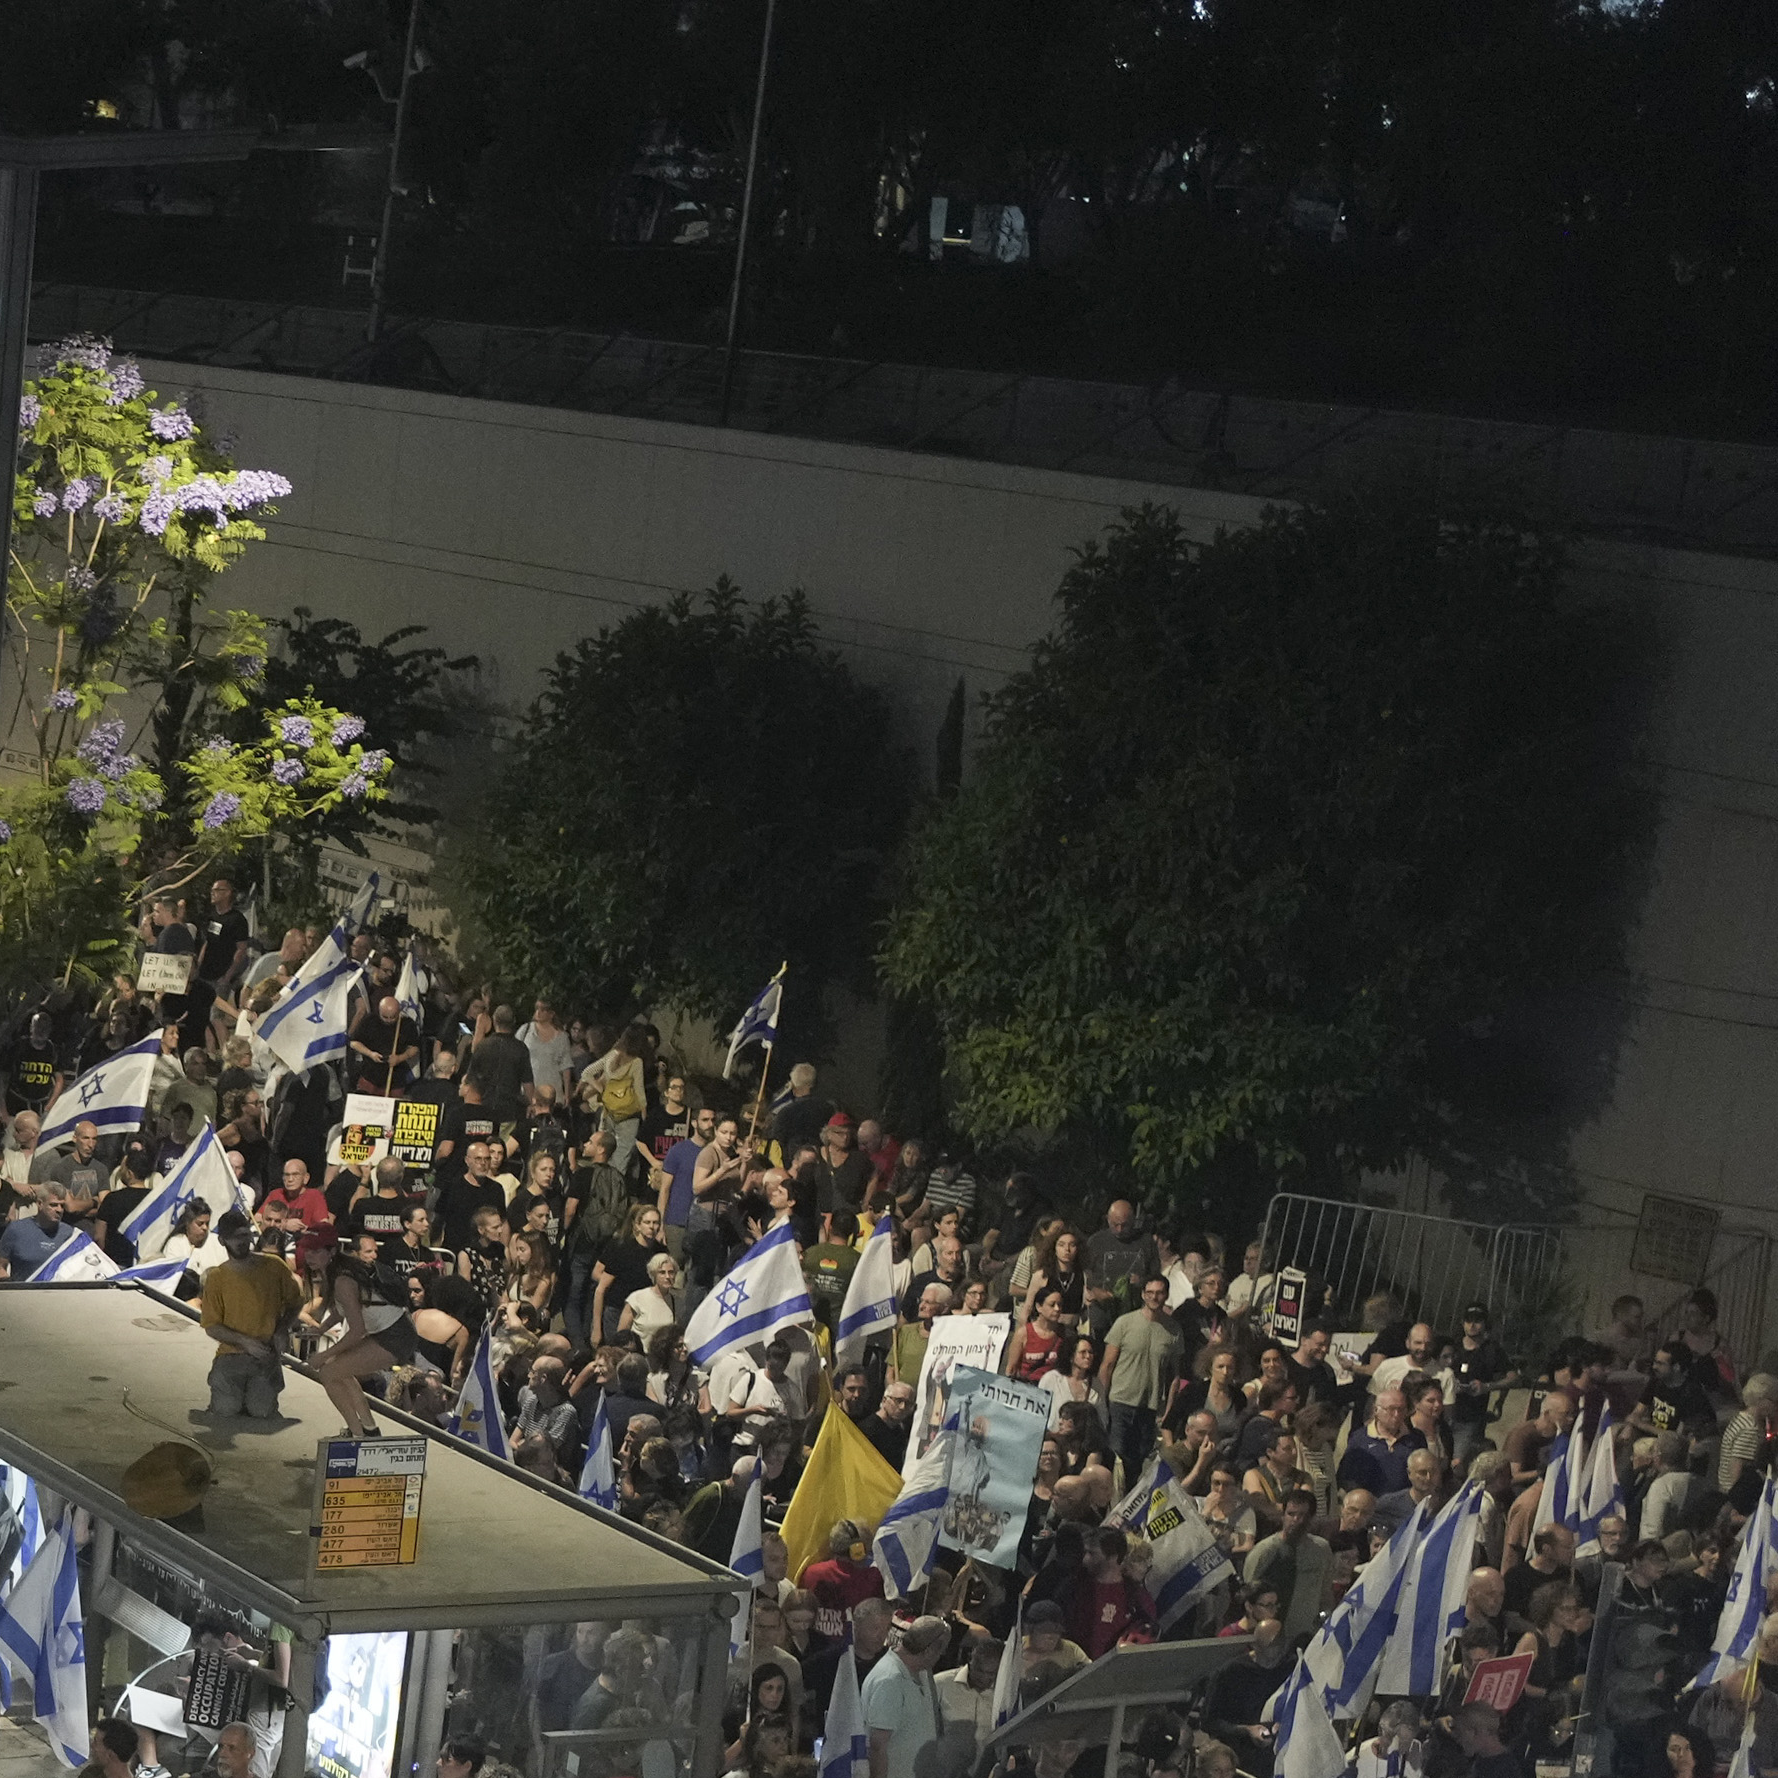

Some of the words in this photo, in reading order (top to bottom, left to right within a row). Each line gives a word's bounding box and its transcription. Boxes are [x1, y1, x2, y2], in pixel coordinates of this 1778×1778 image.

[1024, 1398, 1046, 1416] את
[329, 1481, 340, 1490] 91
[325, 1496, 346, 1506] 635
[325, 1510, 343, 1520] 177
[324, 1525, 344, 1535] 280
[322, 1540, 342, 1549] 477
[321, 1554, 342, 1564] 478
[188, 1662, 208, 1722] DEMOCRACY
[199, 1652, 220, 1724] OCCUPATION
